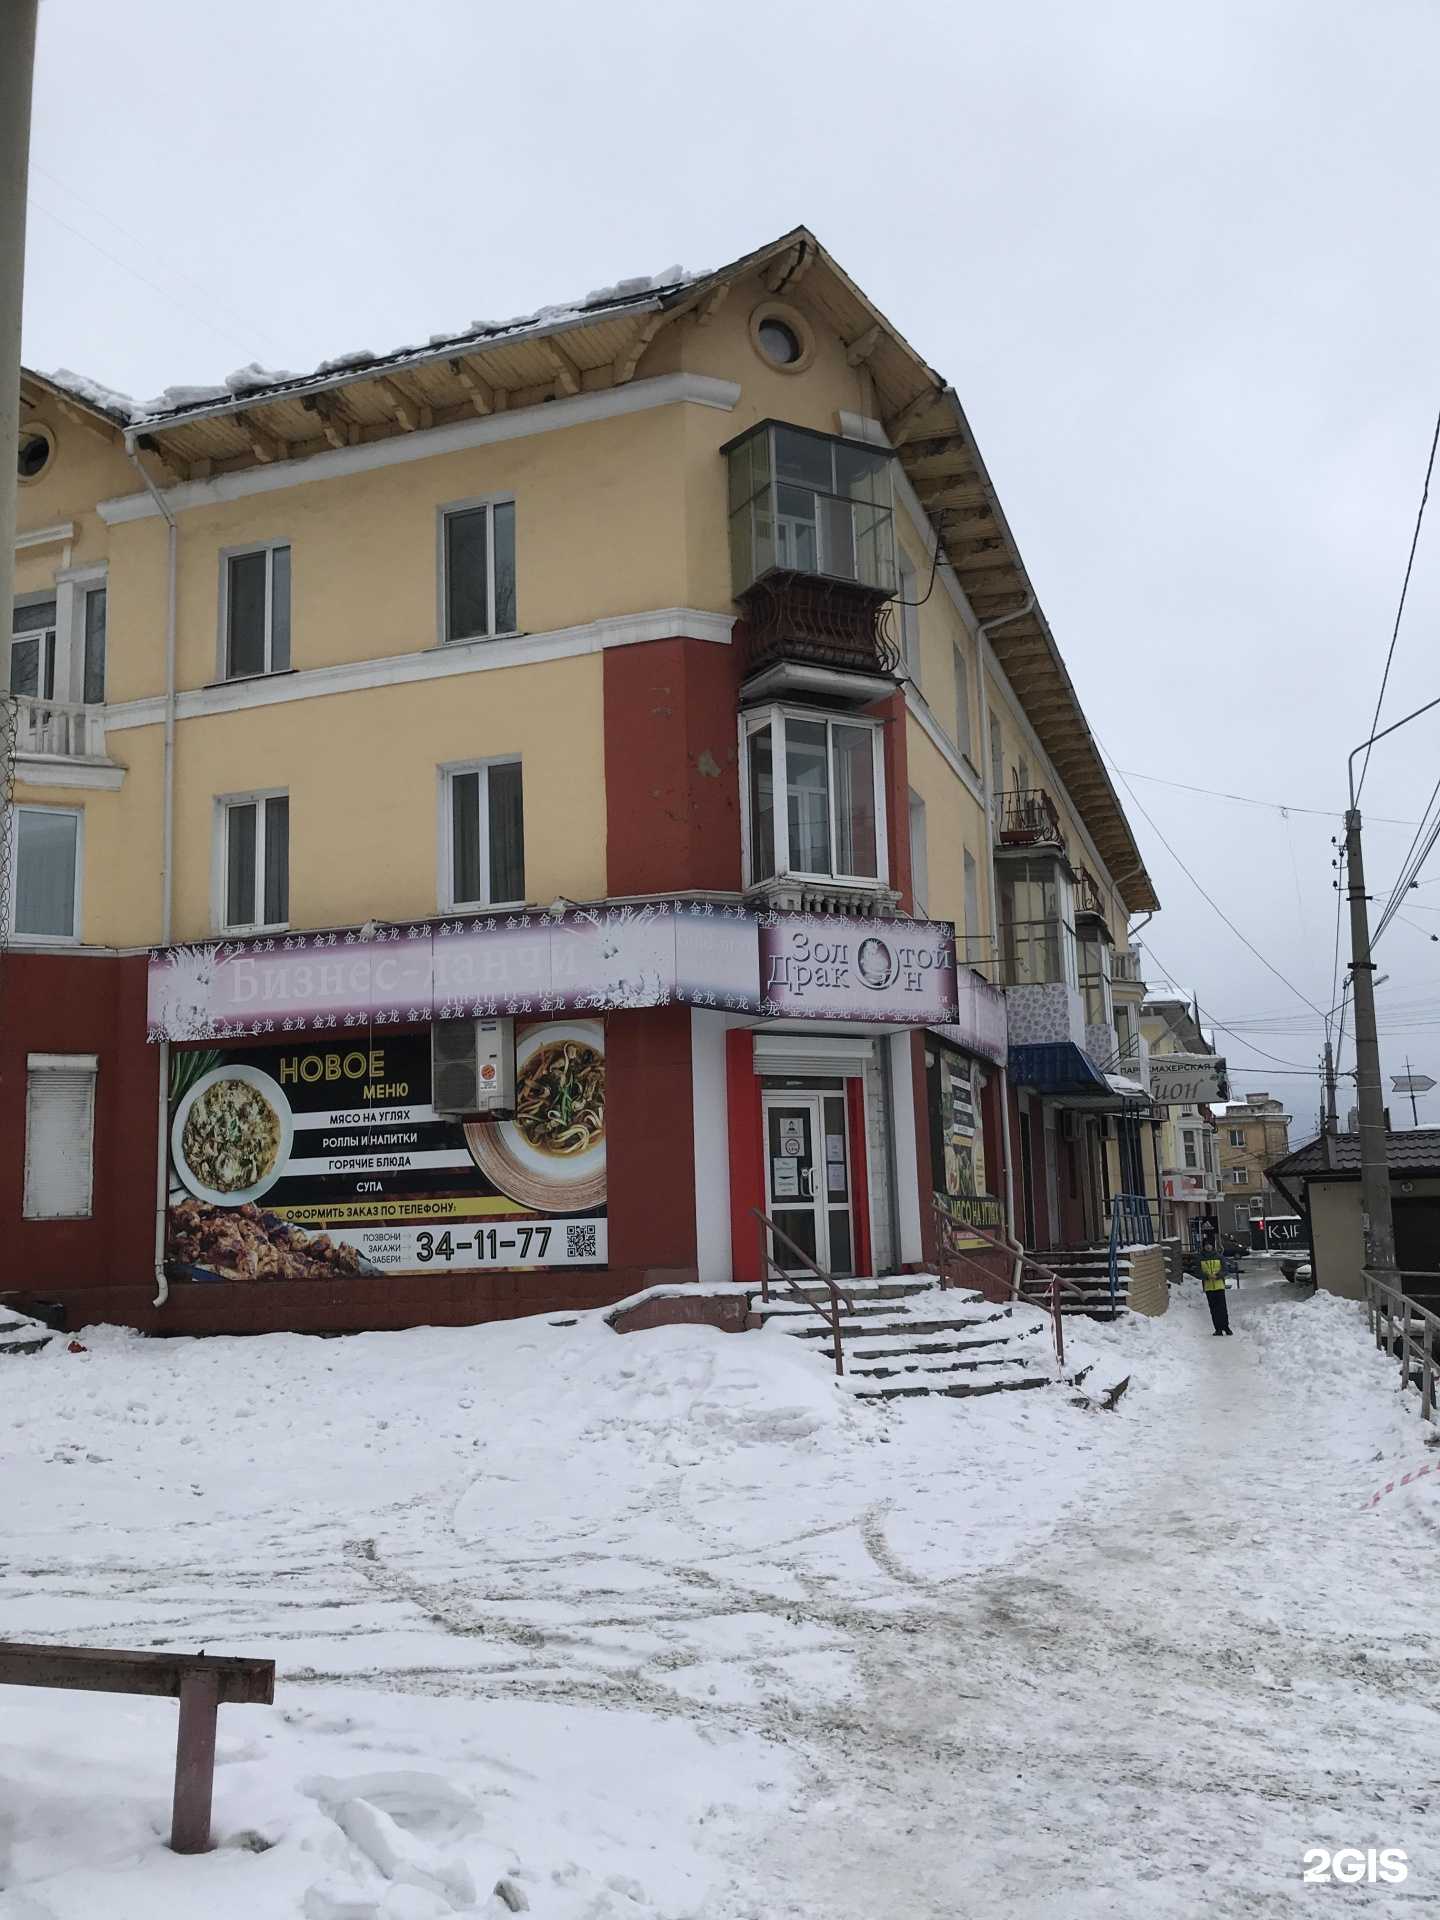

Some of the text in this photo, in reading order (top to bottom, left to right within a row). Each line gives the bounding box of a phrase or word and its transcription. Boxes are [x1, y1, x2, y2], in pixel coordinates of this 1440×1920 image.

[280, 1050, 385, 1084] НОВОЕ
[1120, 1063, 1211, 1075] ПАРМАХЕРСКАЯ
[363, 1082, 409, 1099] МЕНЮ
[329, 1110, 410, 1124] МЯСО НА УГЛЯХ
[322, 1133, 418, 1148] РОЛЛЫ И НАПИТКИ
[329, 1156, 411, 1170] ГОРЯЧИЕ БЛЮДА
[356, 1181, 383, 1192] СУПА
[286, 1202, 457, 1220] ОФОРМИТЬ ЗАКАЗ ПО ТЕЛЕФОНУ:
[363, 1232, 401, 1242] ПОЗВОНИ
[1268, 1224, 1301, 1239] KAIF
[368, 1244, 401, 1253] ЗАКАЖИ
[416, 1226, 552, 1262] 34-11-77
[371, 1255, 401, 1264] ЗАБЕРИ
